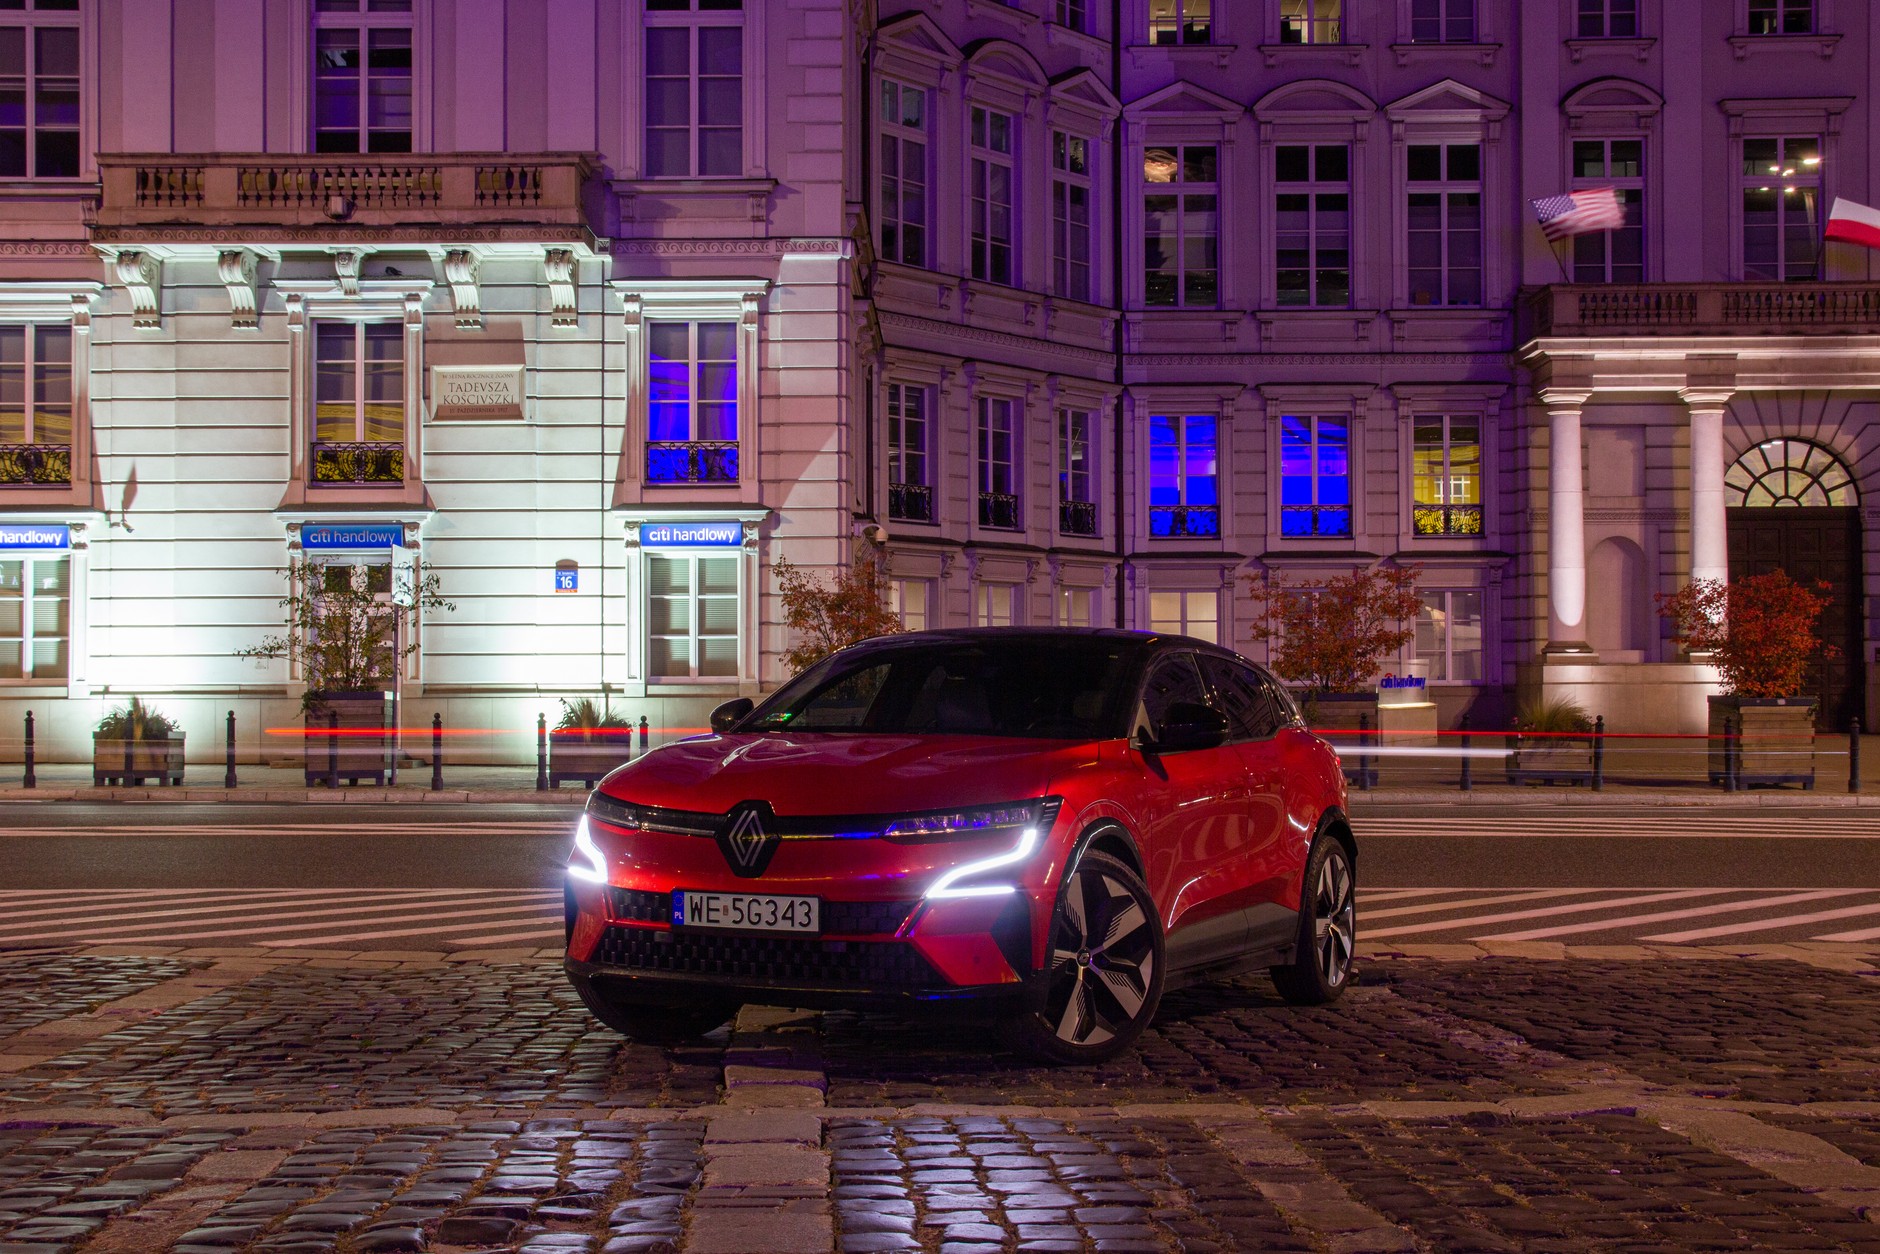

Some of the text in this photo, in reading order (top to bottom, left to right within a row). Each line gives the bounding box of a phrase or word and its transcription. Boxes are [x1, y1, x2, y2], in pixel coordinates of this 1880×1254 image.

[448, 382, 509, 393] TADEVSZA
[443, 393, 514, 405] KOŚCIVSZKI
[0, 530, 62, 546] handlowy
[310, 529, 395, 545] citi handlowy
[649, 527, 736, 544] citi handlowy
[560, 576, 573, 589] 16
[674, 911, 683, 920] PL
[689, 895, 813, 928] WE 5G343
